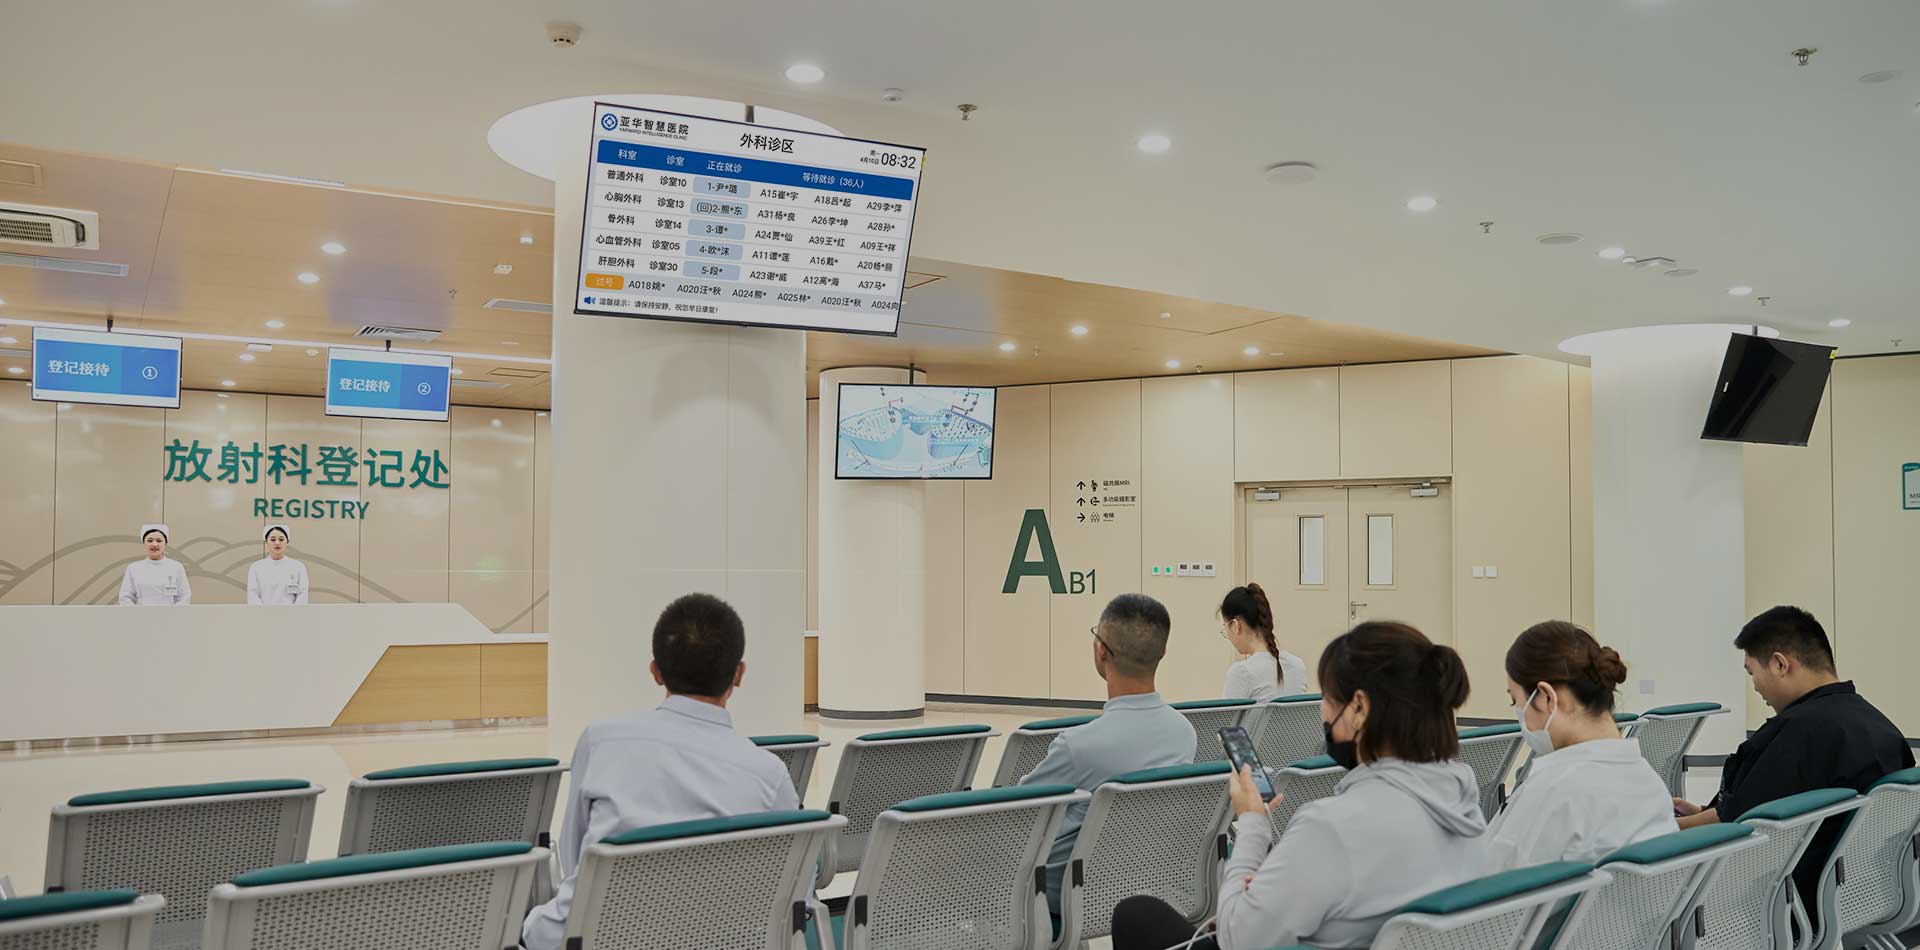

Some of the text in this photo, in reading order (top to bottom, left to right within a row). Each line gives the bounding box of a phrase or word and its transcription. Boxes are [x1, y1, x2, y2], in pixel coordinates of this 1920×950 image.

[620, 116, 689, 135] 亚华智慧医院
[740, 133, 795, 154] 外科诊区
[618, 148, 637, 160] 科室
[666, 155, 685, 167] 诊室
[706, 160, 742, 174] 正在就诊
[881, 152, 916, 169] 08:32
[607, 169, 644, 183] 普通外科
[659, 175, 687, 187] 诊室10
[604, 191, 642, 204] 心胸外科
[657, 197, 685, 209] 诊室13
[607, 213, 635, 226] 骨外科
[655, 218, 682, 230] 诊室14
[596, 234, 642, 247] 心血管外科
[651, 240, 681, 251] 诊室05
[598, 256, 635, 268] 肝胆外科
[649, 260, 678, 272] 诊室30
[47, 359, 111, 377] 登记接待
[339, 377, 391, 393] 登记接待
[163, 438, 451, 489] 放射科登记处
[253, 497, 370, 520] REGISTRY
[1002, 508, 1096, 594] A B1
